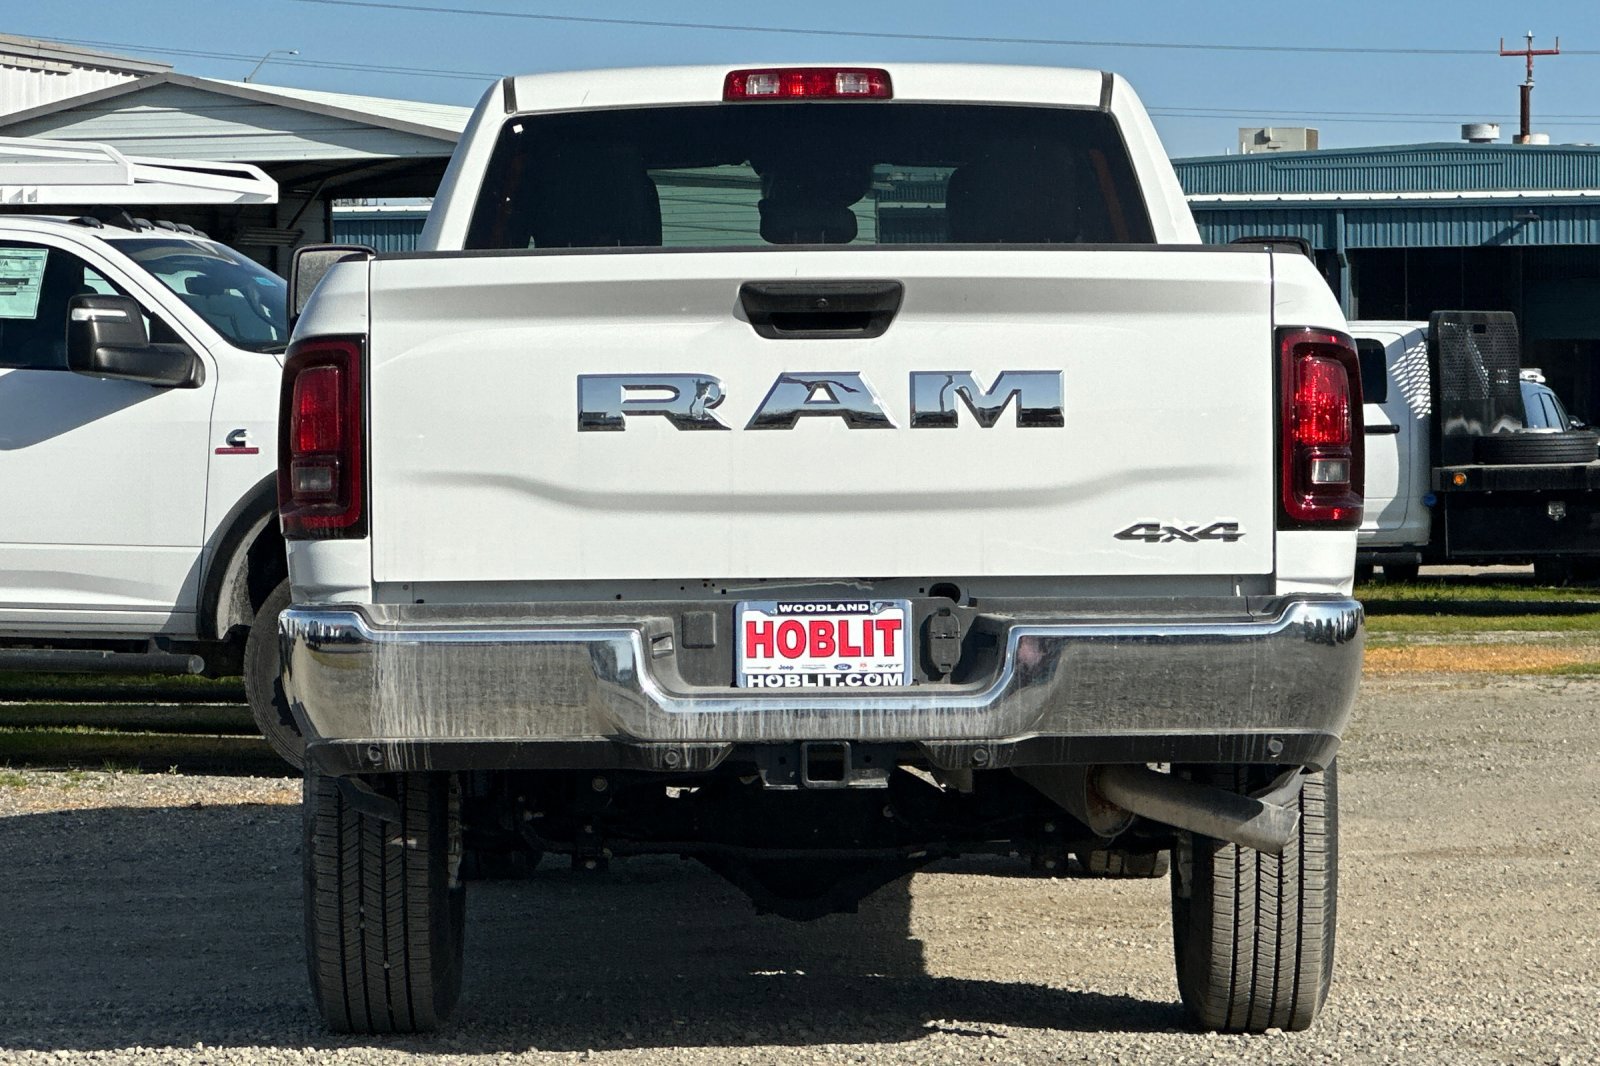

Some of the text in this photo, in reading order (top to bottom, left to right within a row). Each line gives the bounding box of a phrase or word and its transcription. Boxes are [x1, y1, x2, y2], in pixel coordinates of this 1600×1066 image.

[577, 370, 1064, 431] RAM
[778, 603, 869, 613] WOODLAND
[746, 619, 902, 659] HOBLIT
[778, 664, 794, 672] Jeep
[747, 673, 903, 688] HOBLIT.COM
